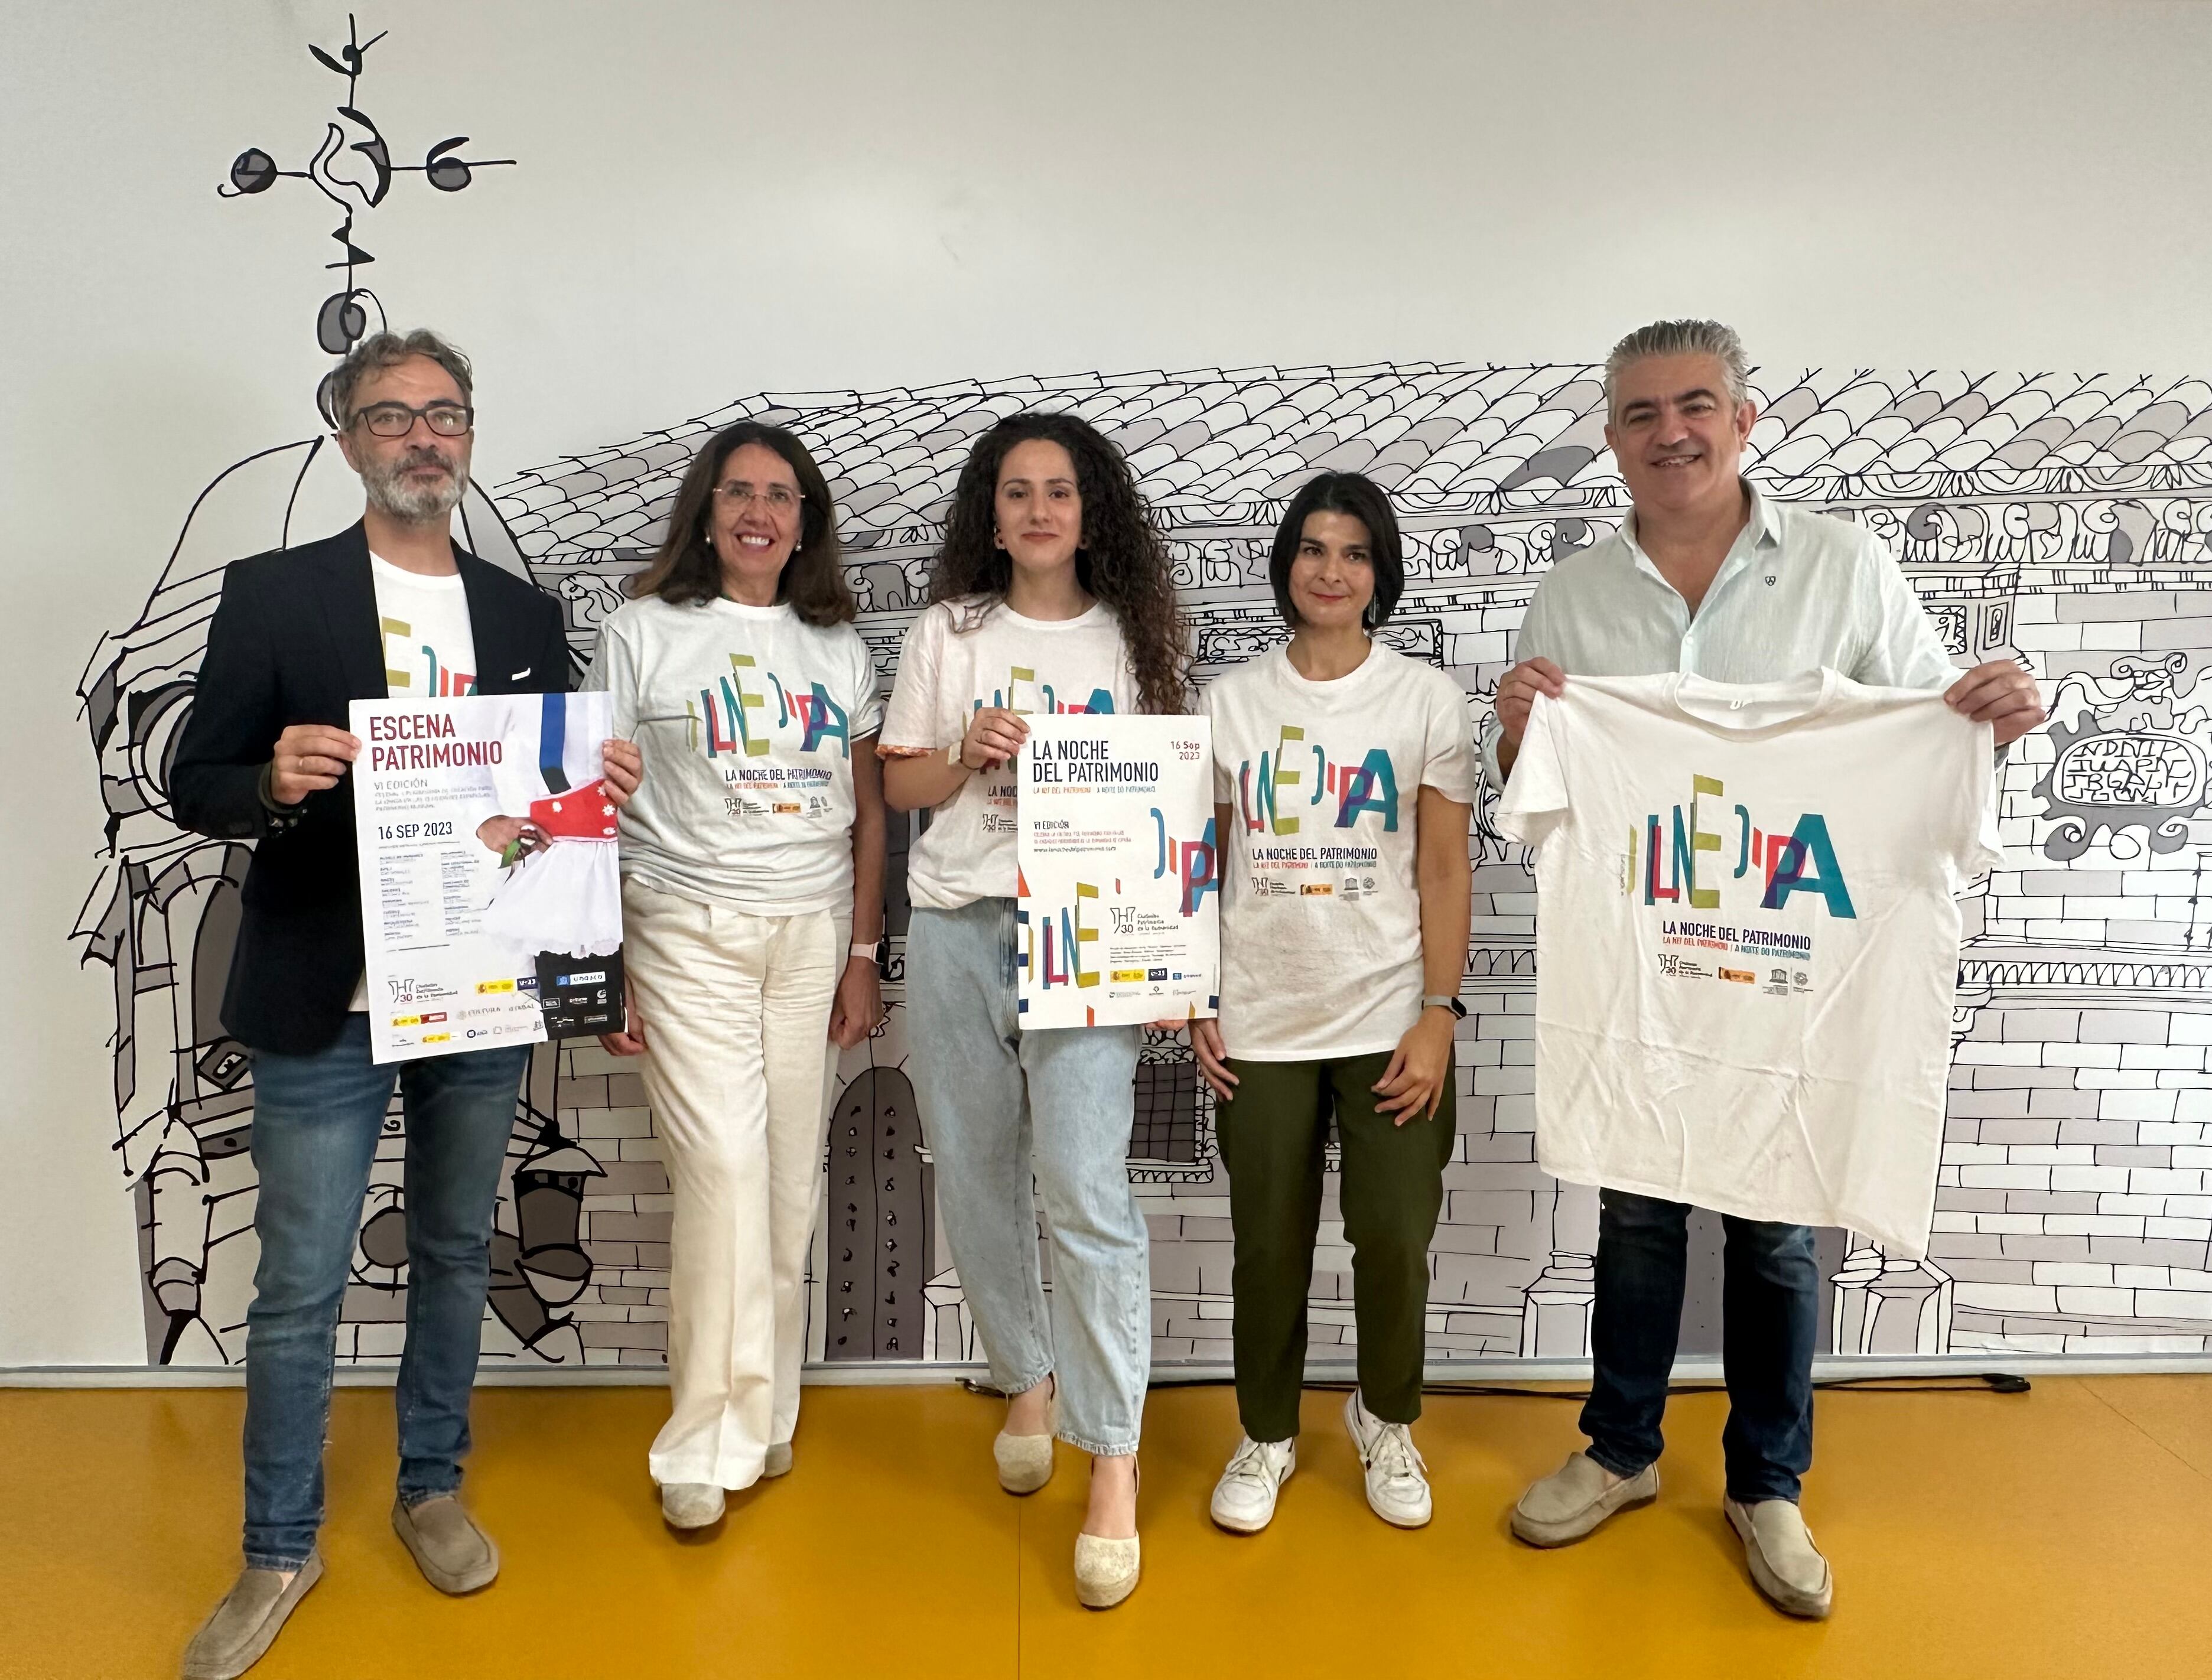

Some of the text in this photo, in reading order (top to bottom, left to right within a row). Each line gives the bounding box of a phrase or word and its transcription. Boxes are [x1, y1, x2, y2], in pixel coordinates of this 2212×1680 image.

[370, 714, 456, 741] ESCENA
[1033, 740, 1109, 760] LA NOCHE
[1170, 741, 1180, 750] 16
[372, 741, 502, 771] PATRIMONIO
[1179, 752, 1200, 760] 2023
[726, 769, 832, 781] LA NOCHE DEL PATRIMONIO
[1033, 762, 1159, 782] DEL PATRIMONIO
[386, 778, 428, 790] EDICIÓN
[988, 786, 1017, 797] LA NOC
[378, 822, 453, 839] 16 SEP 2023
[1253, 847, 1377, 860] LA NOCHE DEL PATRIMONIO
[1663, 920, 1811, 950] LA NOCHE DEL PATRIMONIO
[400, 994, 412, 1002] 30
